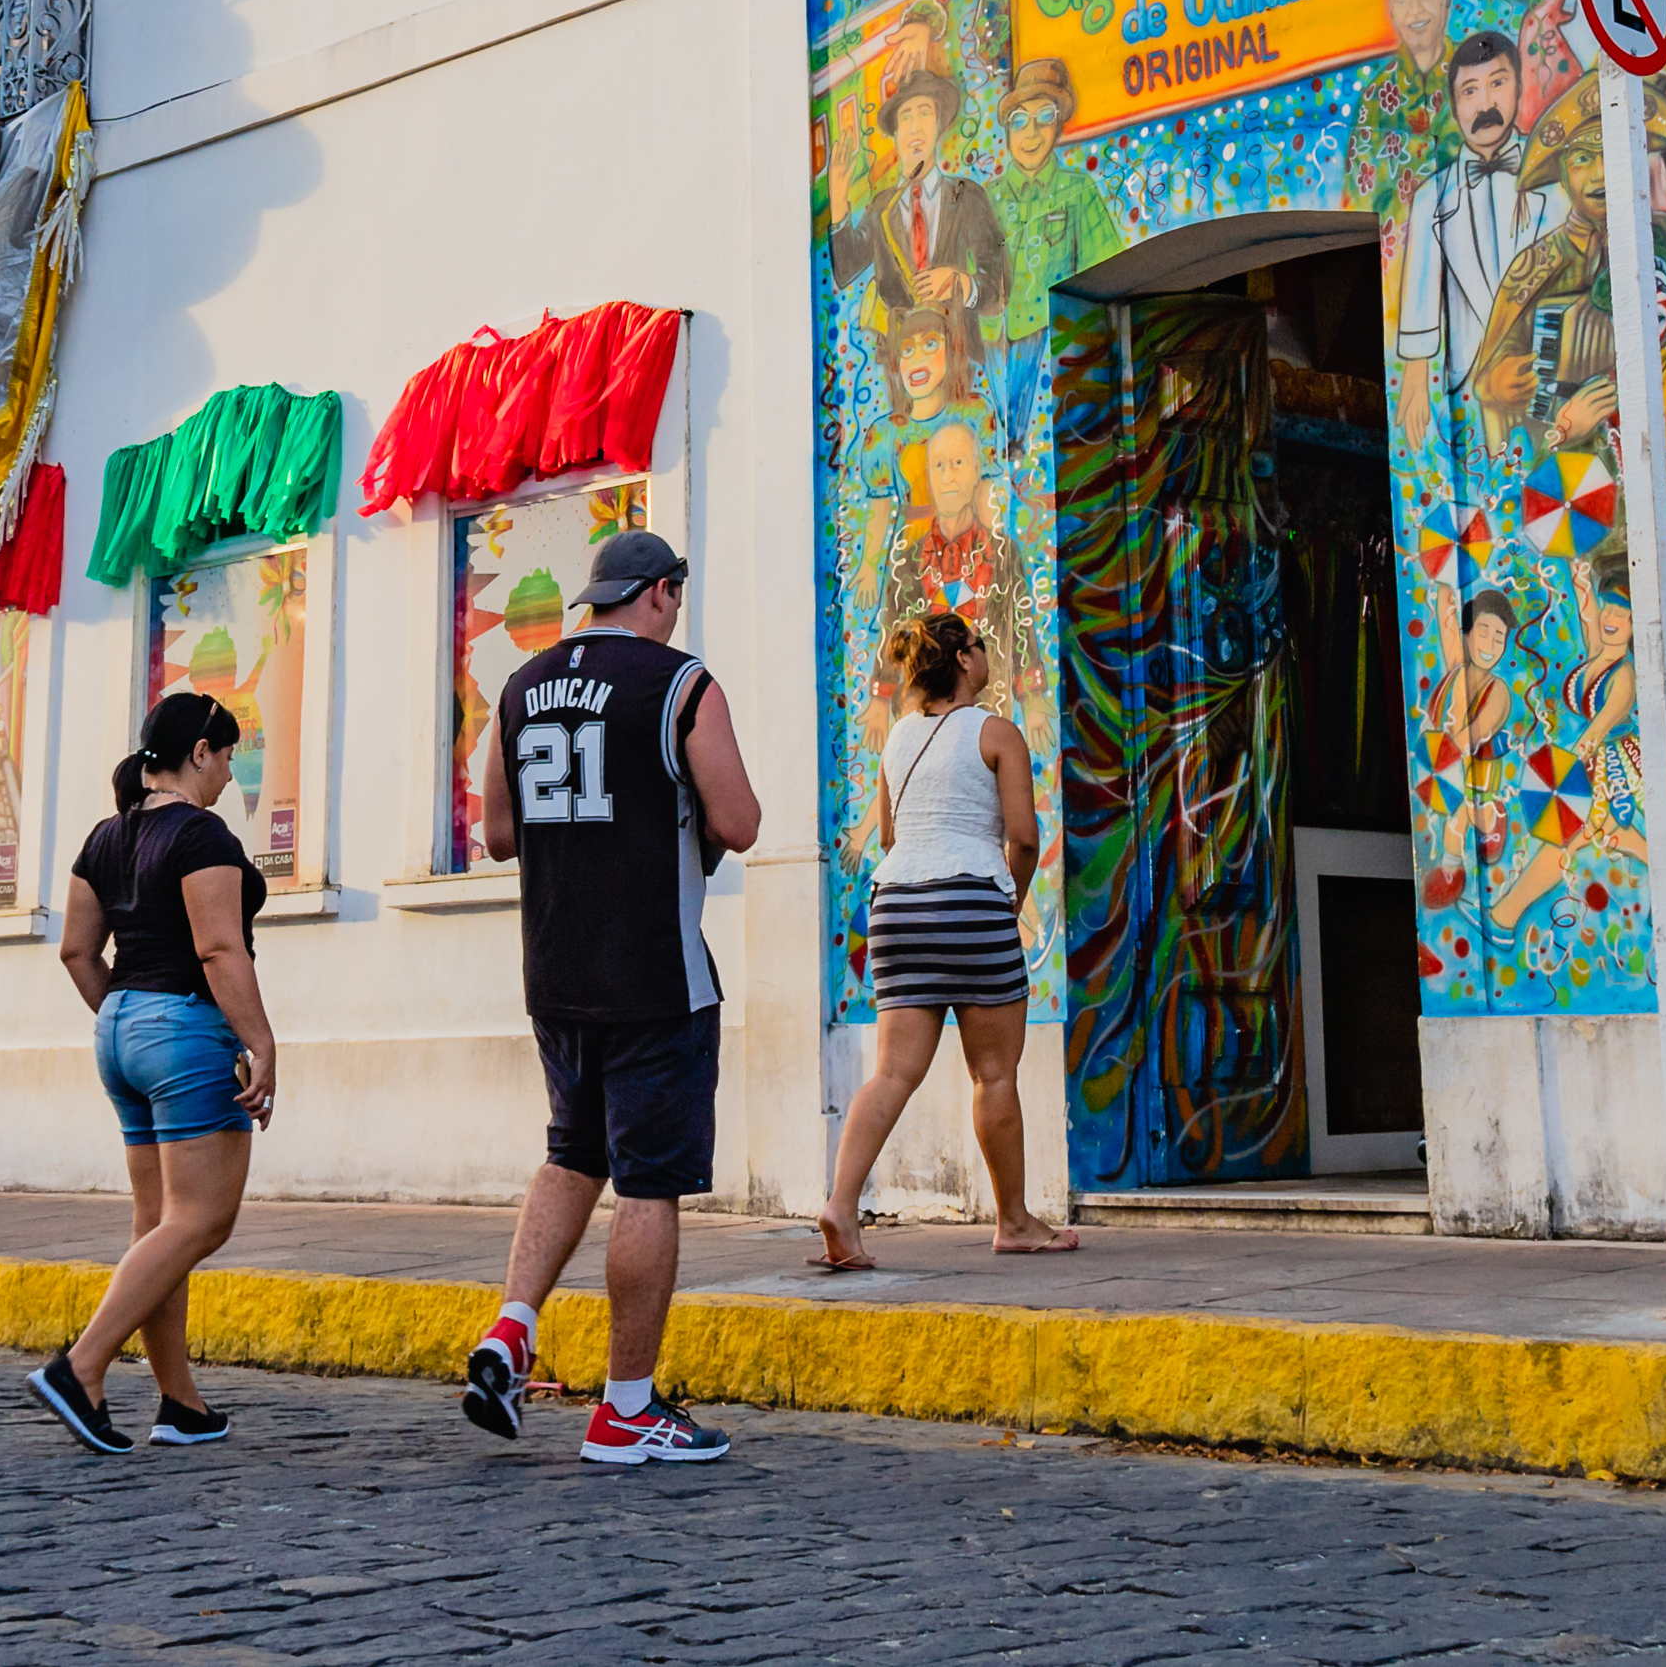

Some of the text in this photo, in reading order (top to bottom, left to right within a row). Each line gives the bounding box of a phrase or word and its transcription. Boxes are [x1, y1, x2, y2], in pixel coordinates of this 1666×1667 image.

[1123, 23, 1279, 96] ORIGINAL
[525, 678, 613, 717] DUNCAN
[517, 721, 614, 823] 21
